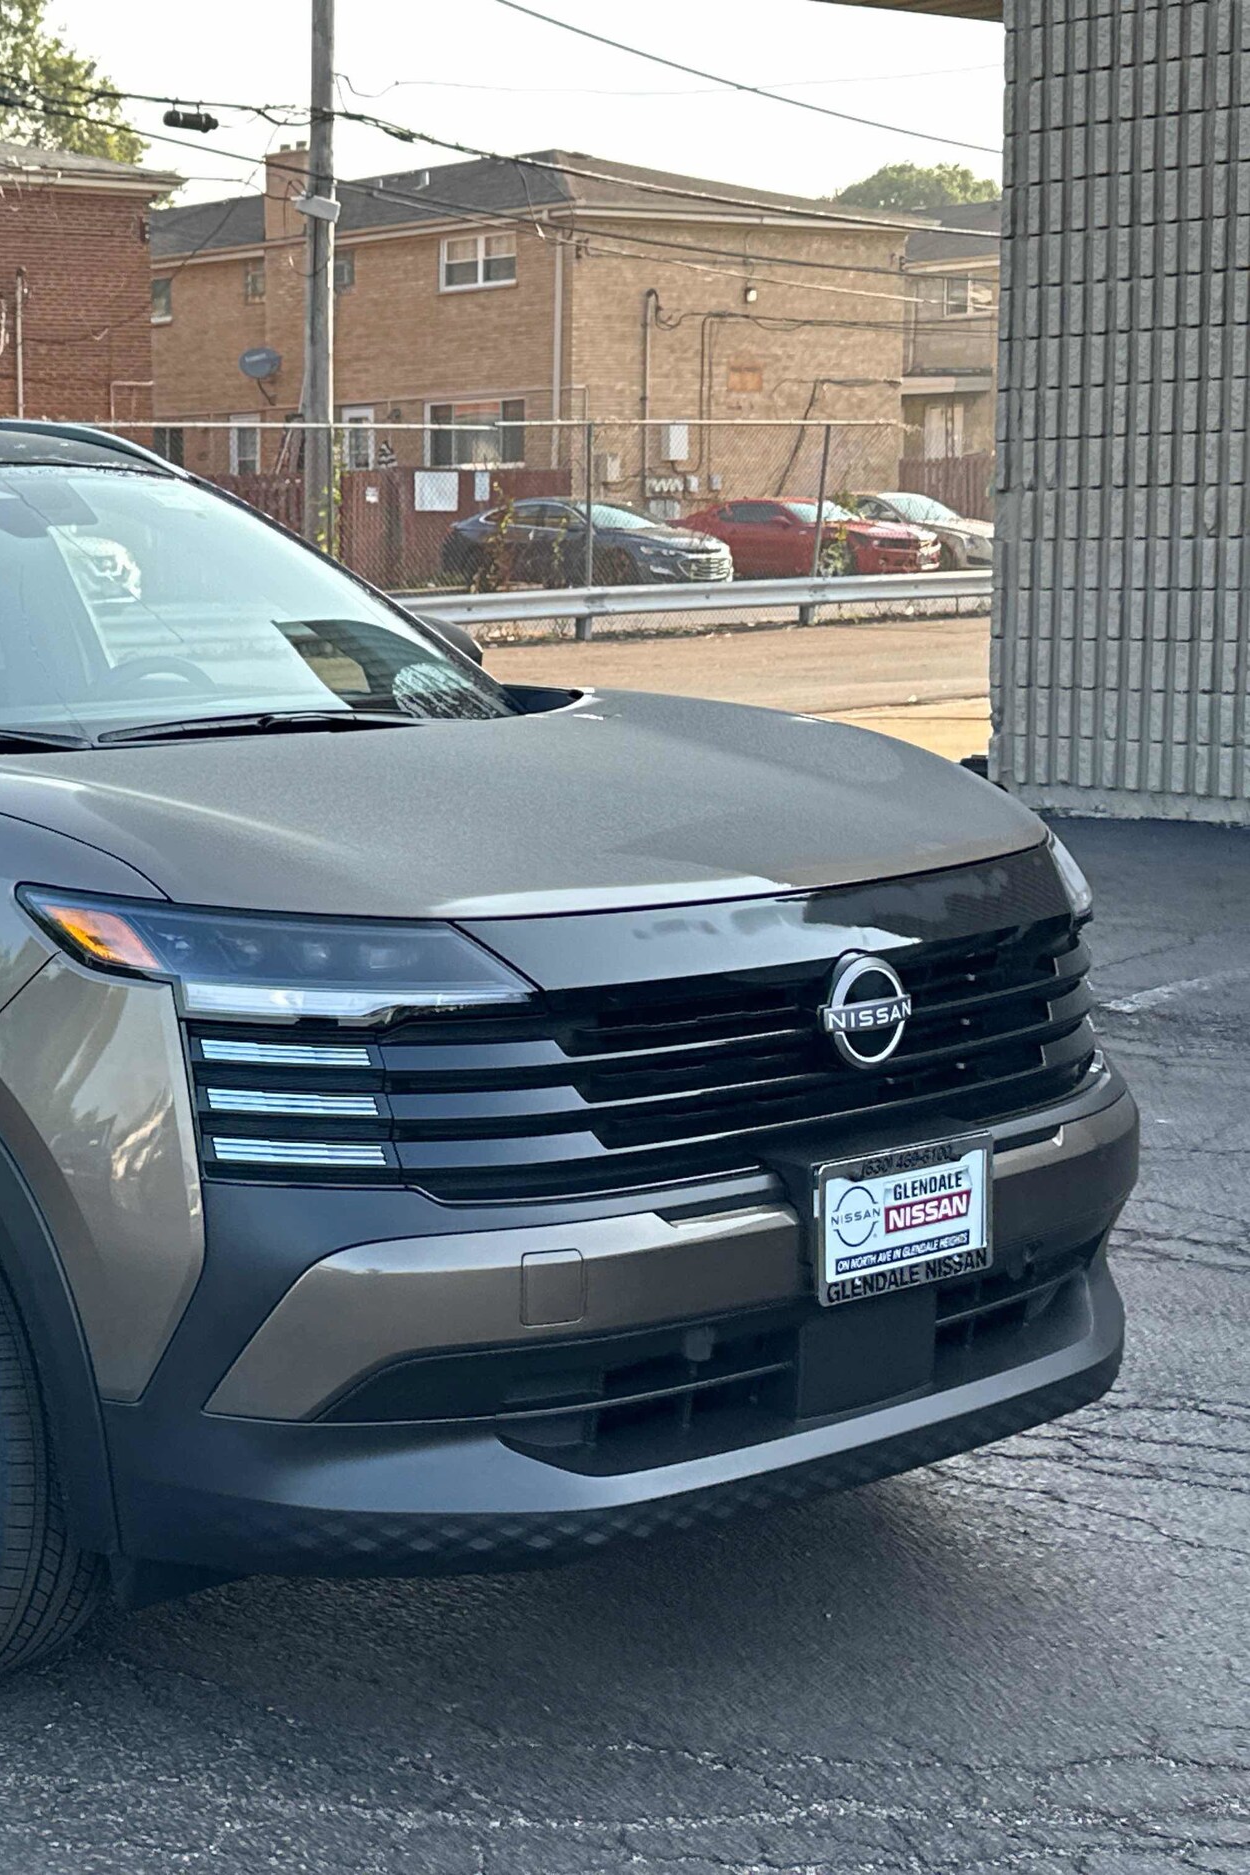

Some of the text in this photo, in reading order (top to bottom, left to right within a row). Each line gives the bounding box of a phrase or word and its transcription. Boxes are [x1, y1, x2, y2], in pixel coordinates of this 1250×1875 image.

[828, 999, 911, 1030] NISSAN
[893, 1171, 963, 1201] GLENDALE
[831, 1207, 881, 1227] NISSAN
[888, 1194, 968, 1230] NISSAN
[837, 1231, 969, 1272] ON NORTH AVE IN GLENDALE HEIGHTS
[827, 1248, 988, 1303] GLENDALE NISSAN
